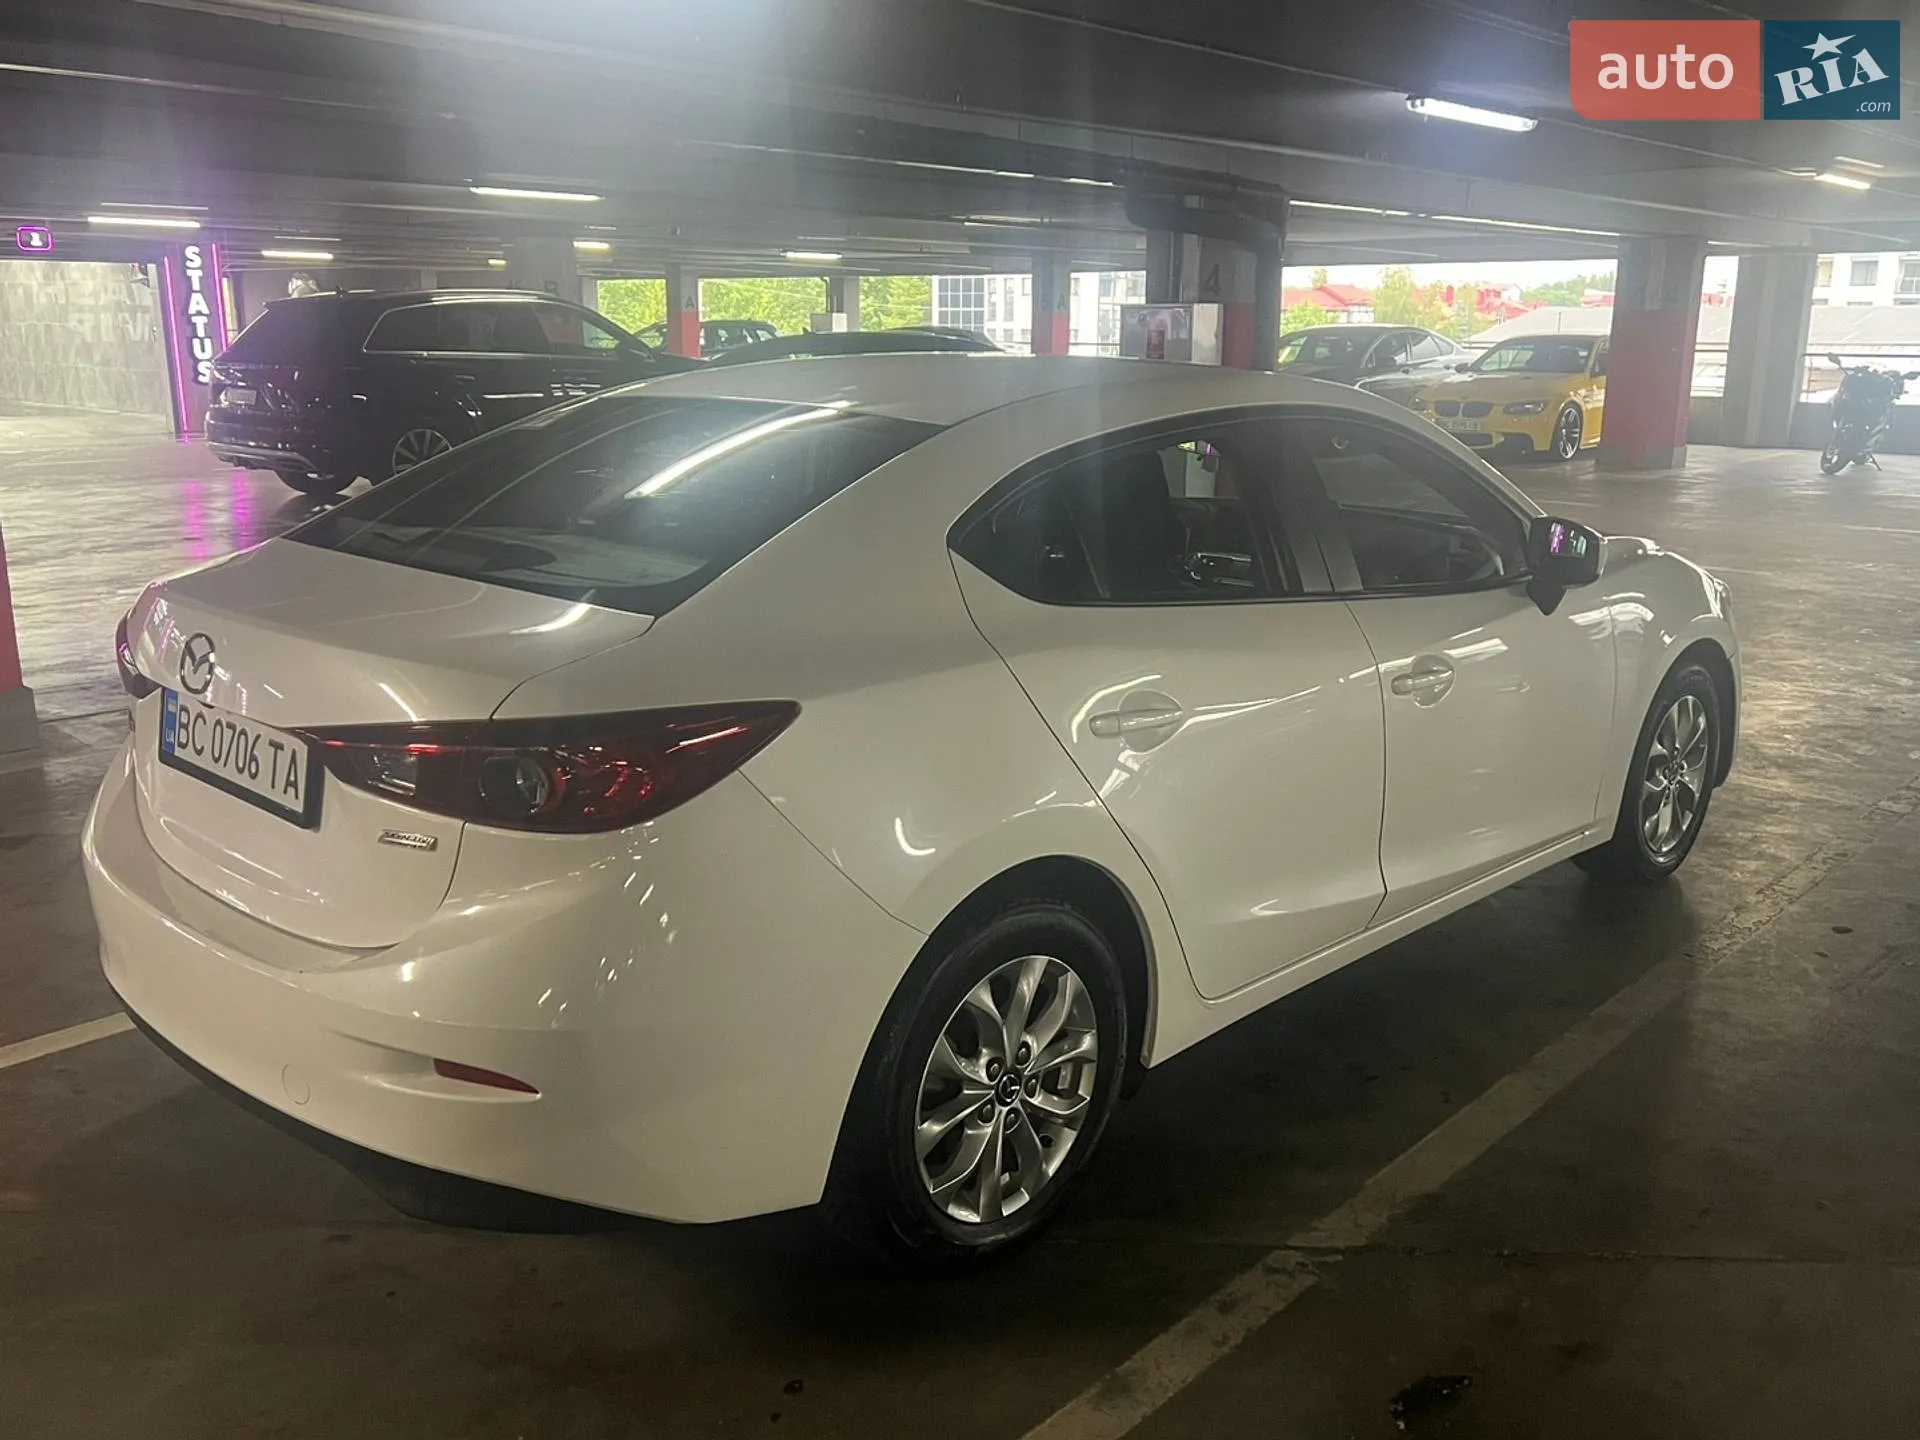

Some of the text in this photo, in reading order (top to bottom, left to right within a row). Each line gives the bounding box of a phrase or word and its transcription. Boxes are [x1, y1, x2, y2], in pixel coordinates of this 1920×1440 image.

[685, 296, 696, 310] A
[1204, 264, 1222, 297] 4
[184, 246, 214, 384] STATUS
[177, 703, 300, 800] BC 0706 TA
